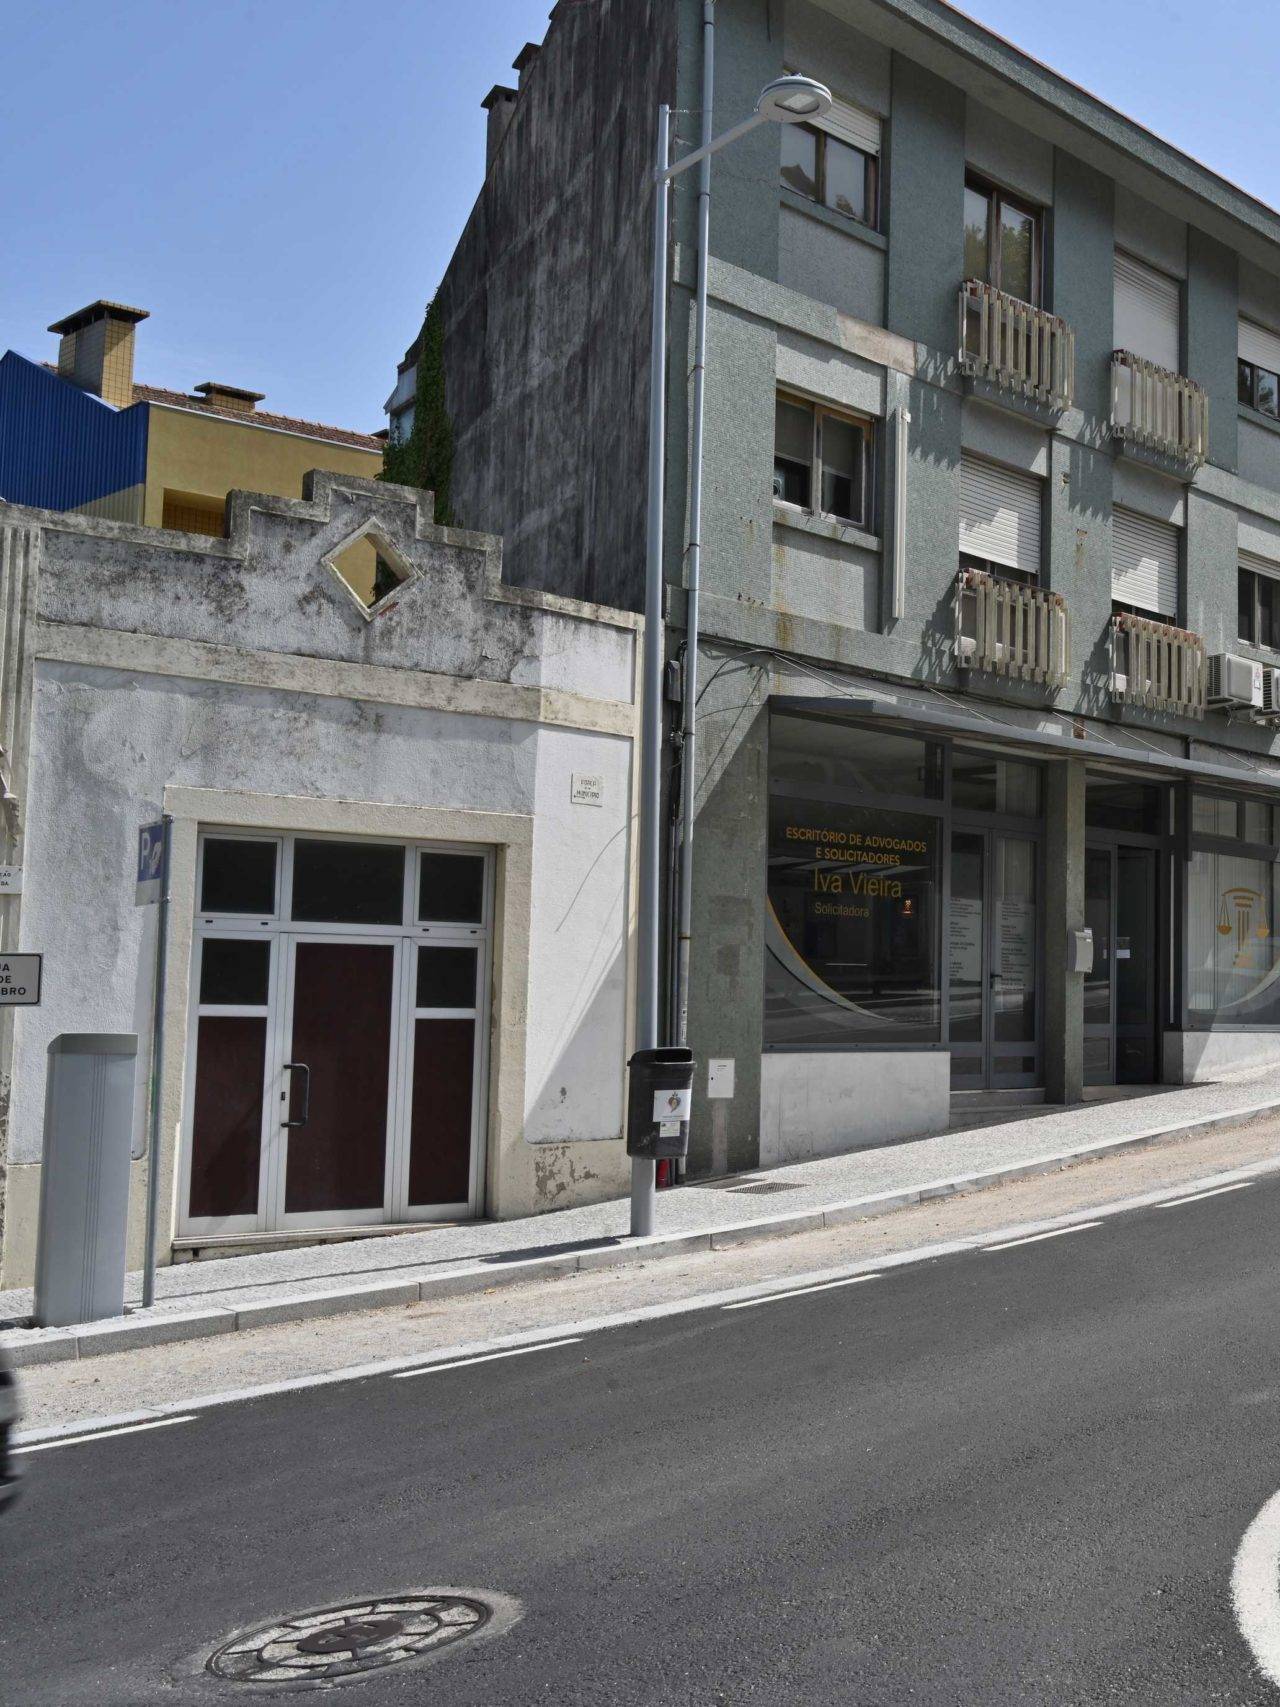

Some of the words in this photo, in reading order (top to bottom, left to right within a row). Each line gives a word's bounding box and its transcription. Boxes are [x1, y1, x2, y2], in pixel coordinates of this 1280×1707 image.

[786, 827, 847, 844] ESCRITÓRIO
[850, 834, 862, 846] DE
[864, 836, 927, 853] ADVOGADOS
[815, 847, 822, 859] E
[824, 848, 901, 865] SOLICITADORES
[813, 867, 843, 893] Iva
[849, 870, 902, 898] Vieira
[814, 902, 870, 918] Solicitadora
